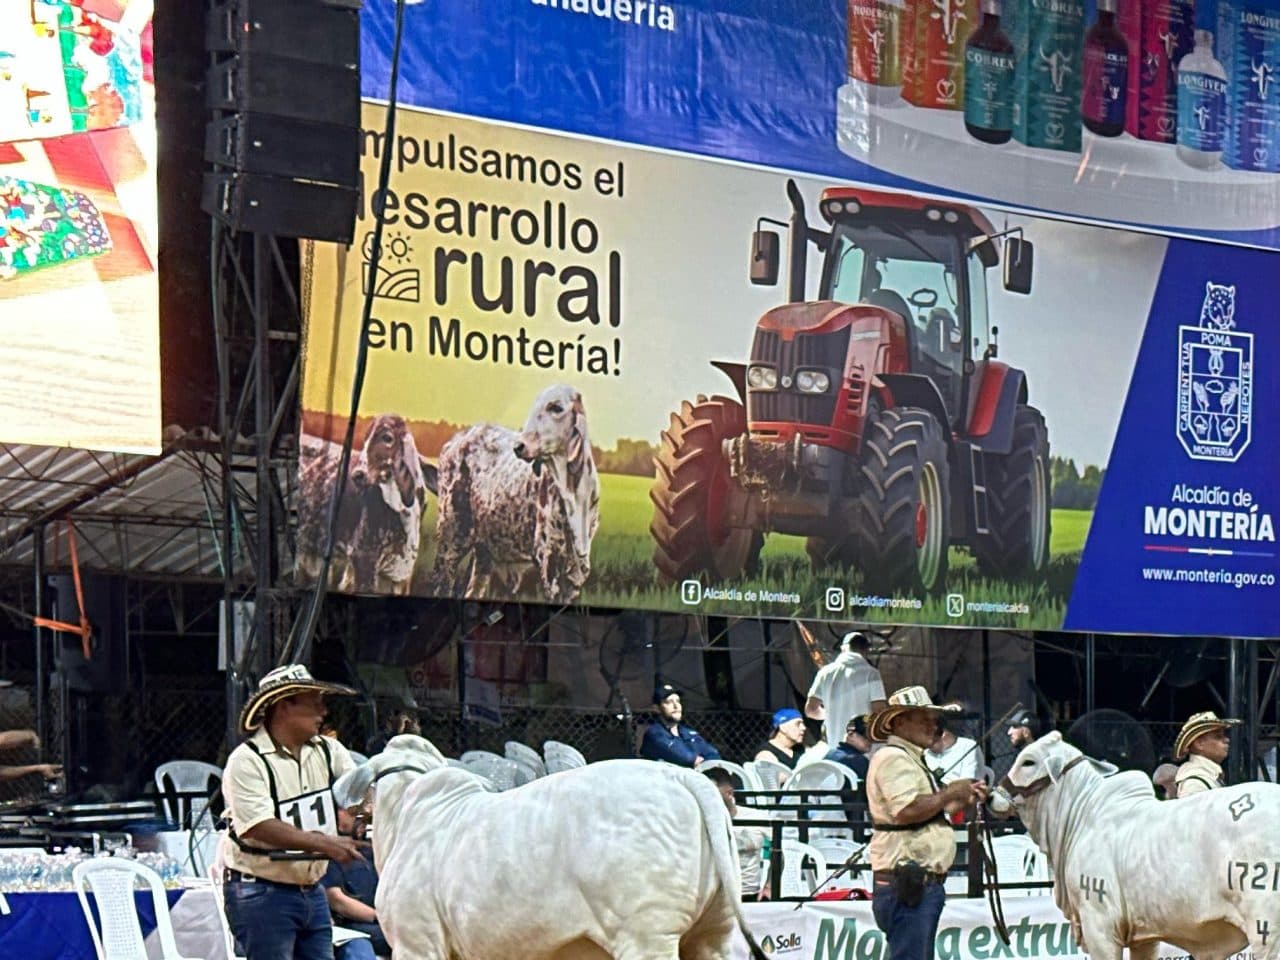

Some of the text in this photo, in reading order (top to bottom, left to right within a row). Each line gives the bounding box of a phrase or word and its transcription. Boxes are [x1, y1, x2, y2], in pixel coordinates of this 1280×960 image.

[360, 128, 623, 197] mpulsamos el
[359, 171, 598, 253] esarrollo
[434, 247, 621, 327] rural
[365, 316, 621, 376] en Montería!
[1201, 333, 1231, 347] POMA
[1180, 343, 1190, 432] CARPENT TUA
[1241, 362, 1250, 424] NEPOTES
[1172, 484, 1252, 507] Alcaldía de
[1144, 504, 1275, 541] MONTERÍA
[1143, 568, 1275, 588] www.monteria.gov.co
[744, 590, 757, 602] de
[286, 796, 326, 831] 11
[1079, 873, 1106, 903] 44
[1227, 861, 1280, 891] 1721
[776, 932, 801, 950] Solla
[1256, 919, 1270, 945] 4
